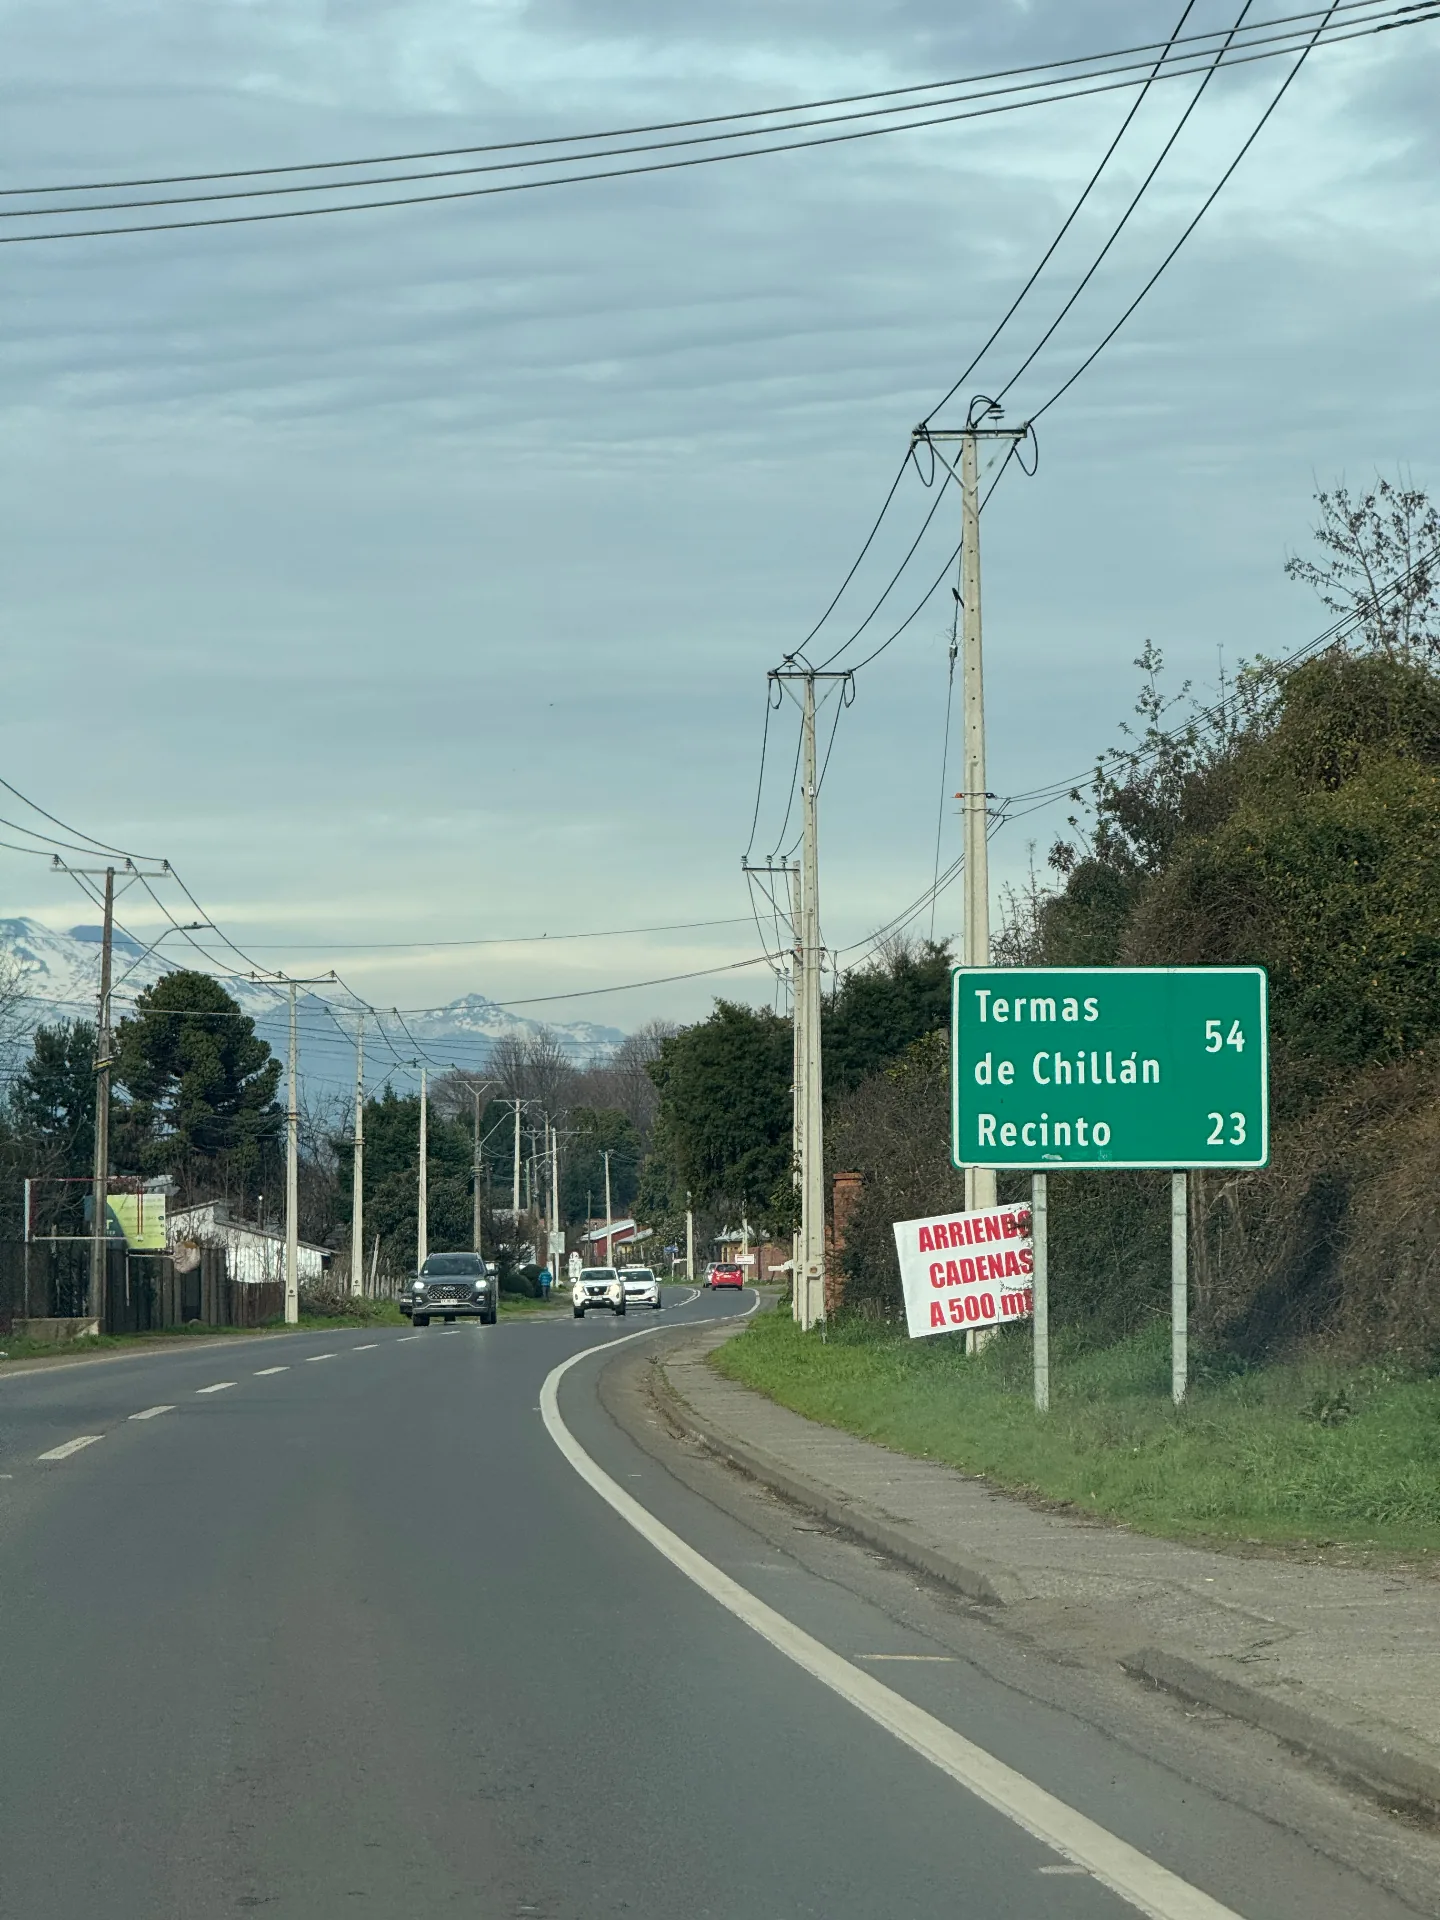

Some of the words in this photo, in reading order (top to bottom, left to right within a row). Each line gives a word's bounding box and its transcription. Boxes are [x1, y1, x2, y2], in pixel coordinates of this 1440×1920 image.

[975, 989, 1099, 1022] Termas
[1205, 1020, 1245, 1053] 54
[974, 1052, 1015, 1085] de
[1033, 1051, 1160, 1085] Chillán
[978, 1113, 1111, 1147] Recinto
[1206, 1112, 1247, 1146] 23
[929, 1248, 1034, 1288] CADENAS
[930, 1301, 946, 1327] A
[949, 1293, 996, 1323] 500
